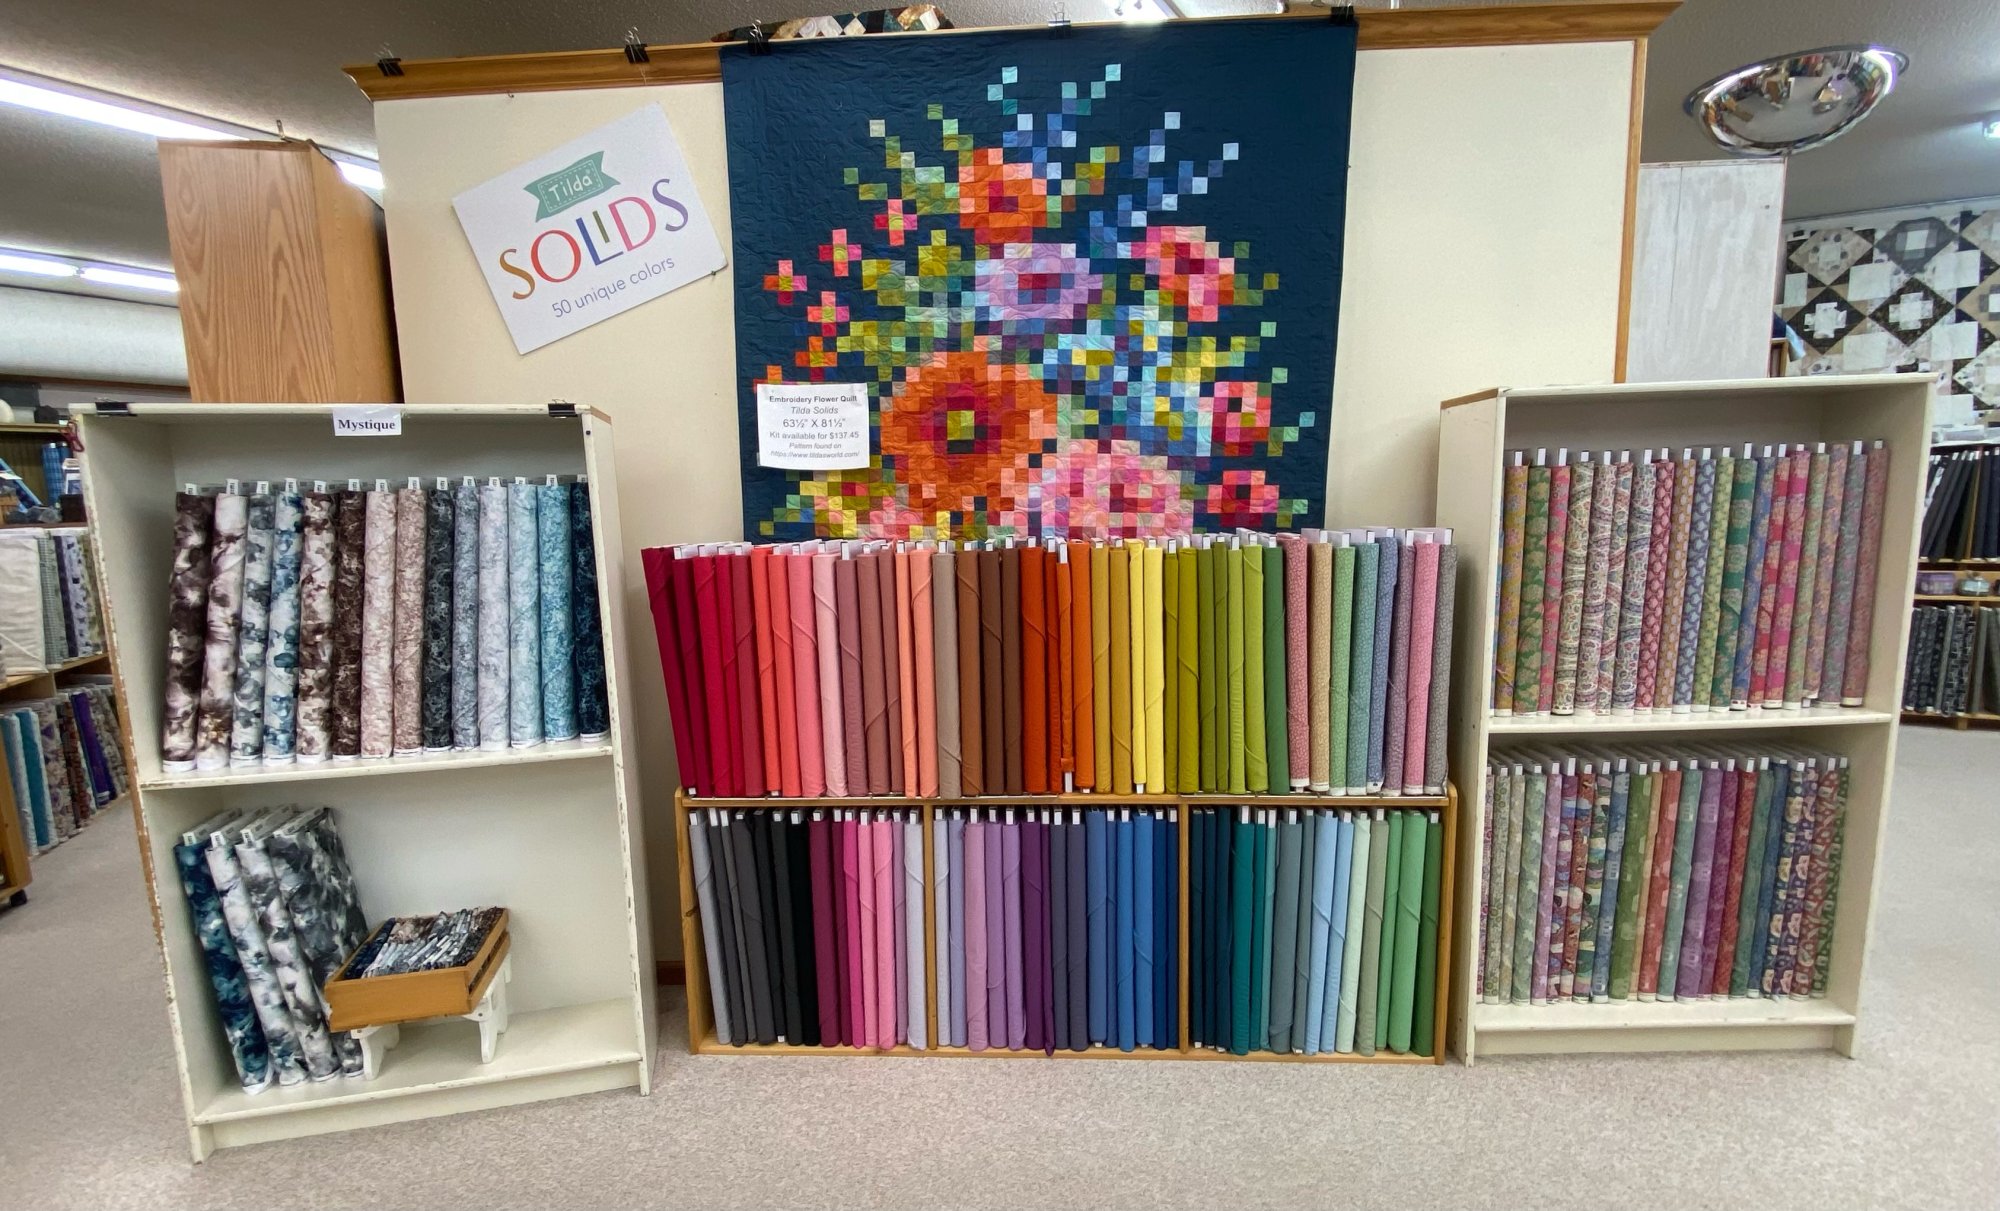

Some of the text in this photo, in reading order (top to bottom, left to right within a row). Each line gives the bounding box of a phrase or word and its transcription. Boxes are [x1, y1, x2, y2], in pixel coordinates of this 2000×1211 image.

[548, 173, 593, 202] Tilda
[499, 178, 689, 300] SOLIDS
[551, 257, 675, 318] 50 unique colors
[769, 395, 858, 405] Embroidery Flower Quilt
[791, 406, 839, 415] Tilda Solids
[338, 419, 396, 432] Mystique
[769, 431, 781, 439] Kit
[781, 431, 816, 440] available
[817, 432, 828, 440] for
[789, 442, 813, 450] Pattern
[813, 442, 833, 450] found
